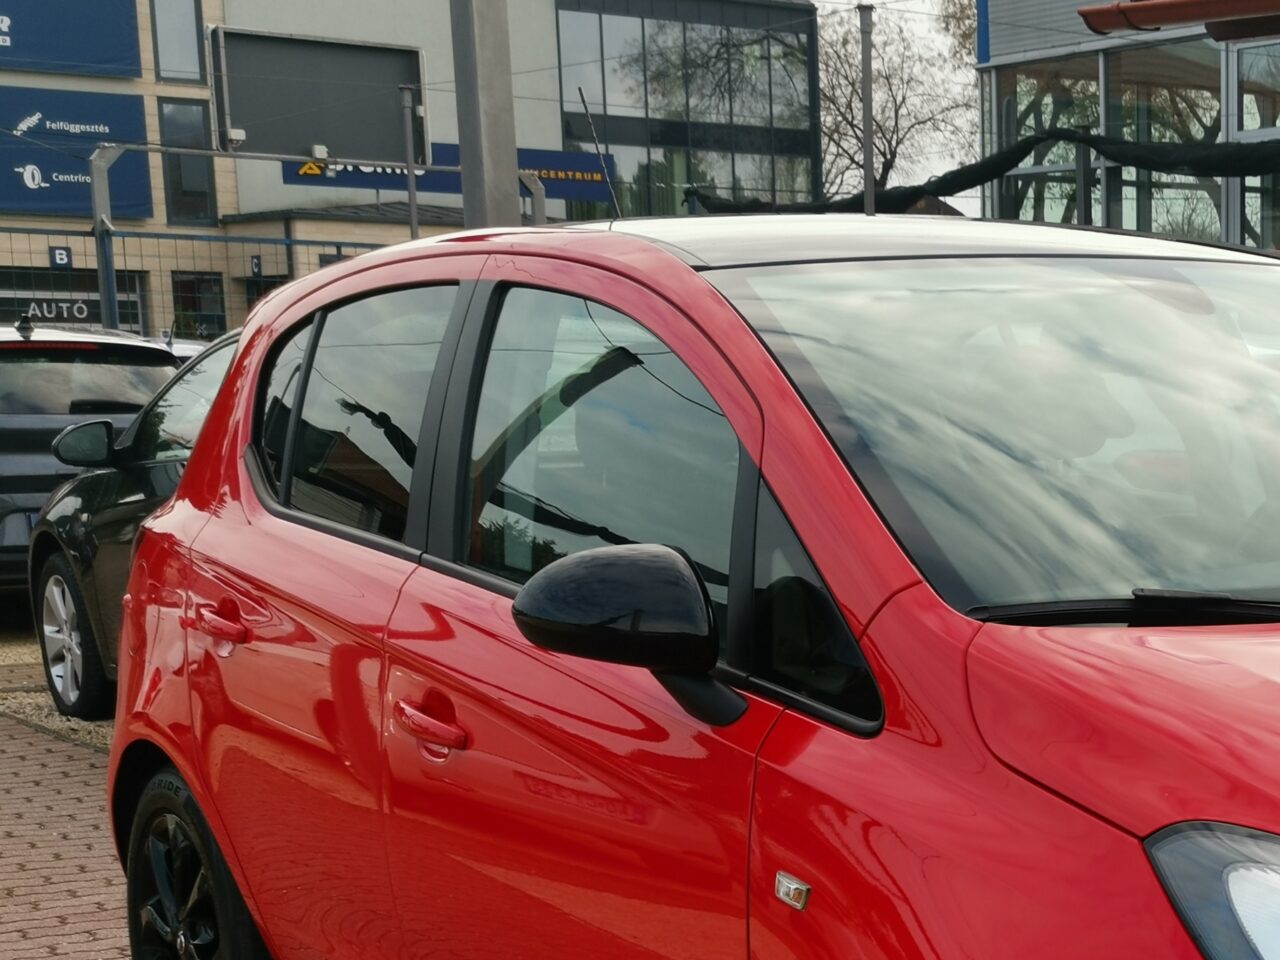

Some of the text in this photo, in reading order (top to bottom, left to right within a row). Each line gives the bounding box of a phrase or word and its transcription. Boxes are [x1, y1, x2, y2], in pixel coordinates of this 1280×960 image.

[45, 121, 110, 133] Felfüggesztés
[55, 249, 68, 264] B
[251, 258, 260, 273] C
[27, 300, 88, 320] AUTÓ
